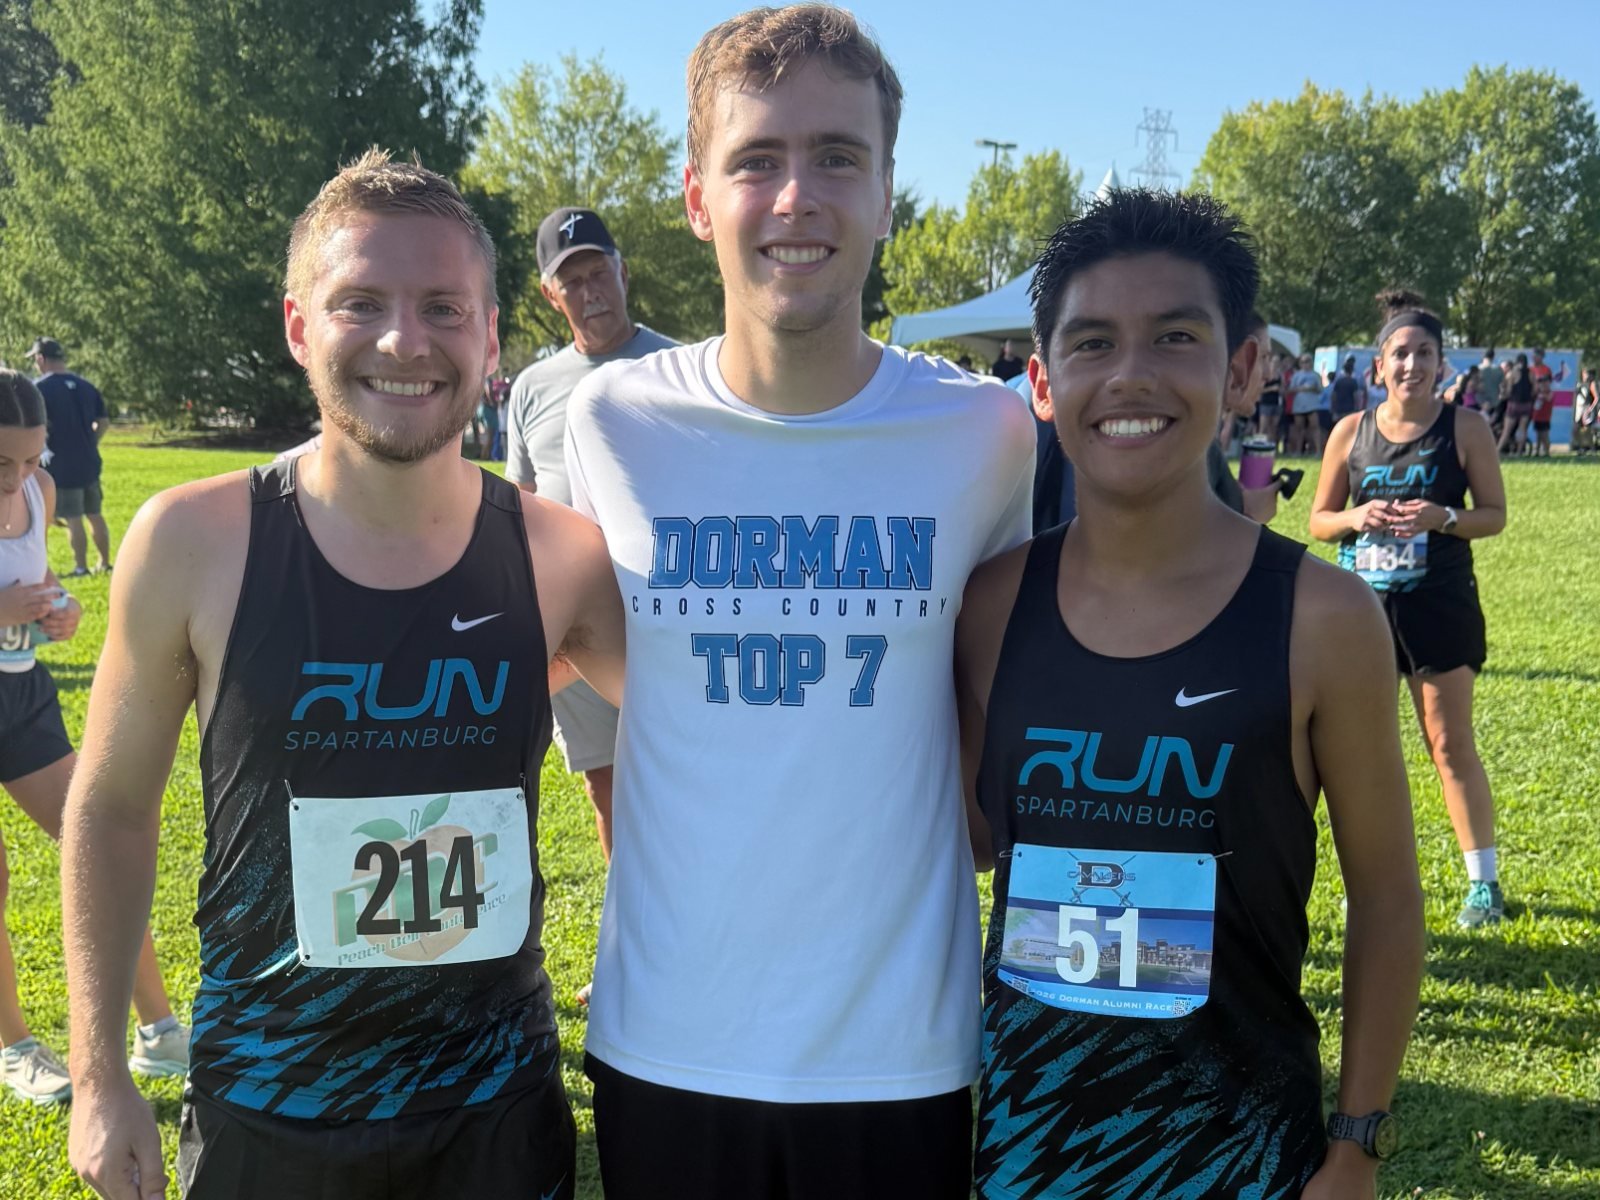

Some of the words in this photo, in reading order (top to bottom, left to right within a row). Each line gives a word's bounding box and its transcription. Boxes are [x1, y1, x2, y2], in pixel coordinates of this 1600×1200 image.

[1362, 464, 1439, 488] RUN
[648, 516, 935, 590] DORMAN
[1365, 543, 1416, 572] 134
[632, 595, 742, 616] CROSS
[782, 596, 947, 617] COUNTRY
[291, 658, 510, 721] RUN
[691, 633, 825, 706] TOP
[846, 635, 888, 707] 7
[284, 725, 497, 750] SPARTANBURG
[1018, 727, 1235, 798] RUN
[1016, 795, 1216, 828] SPARTANBURG
[354, 835, 485, 935] 214
[1055, 904, 1139, 988] 51
